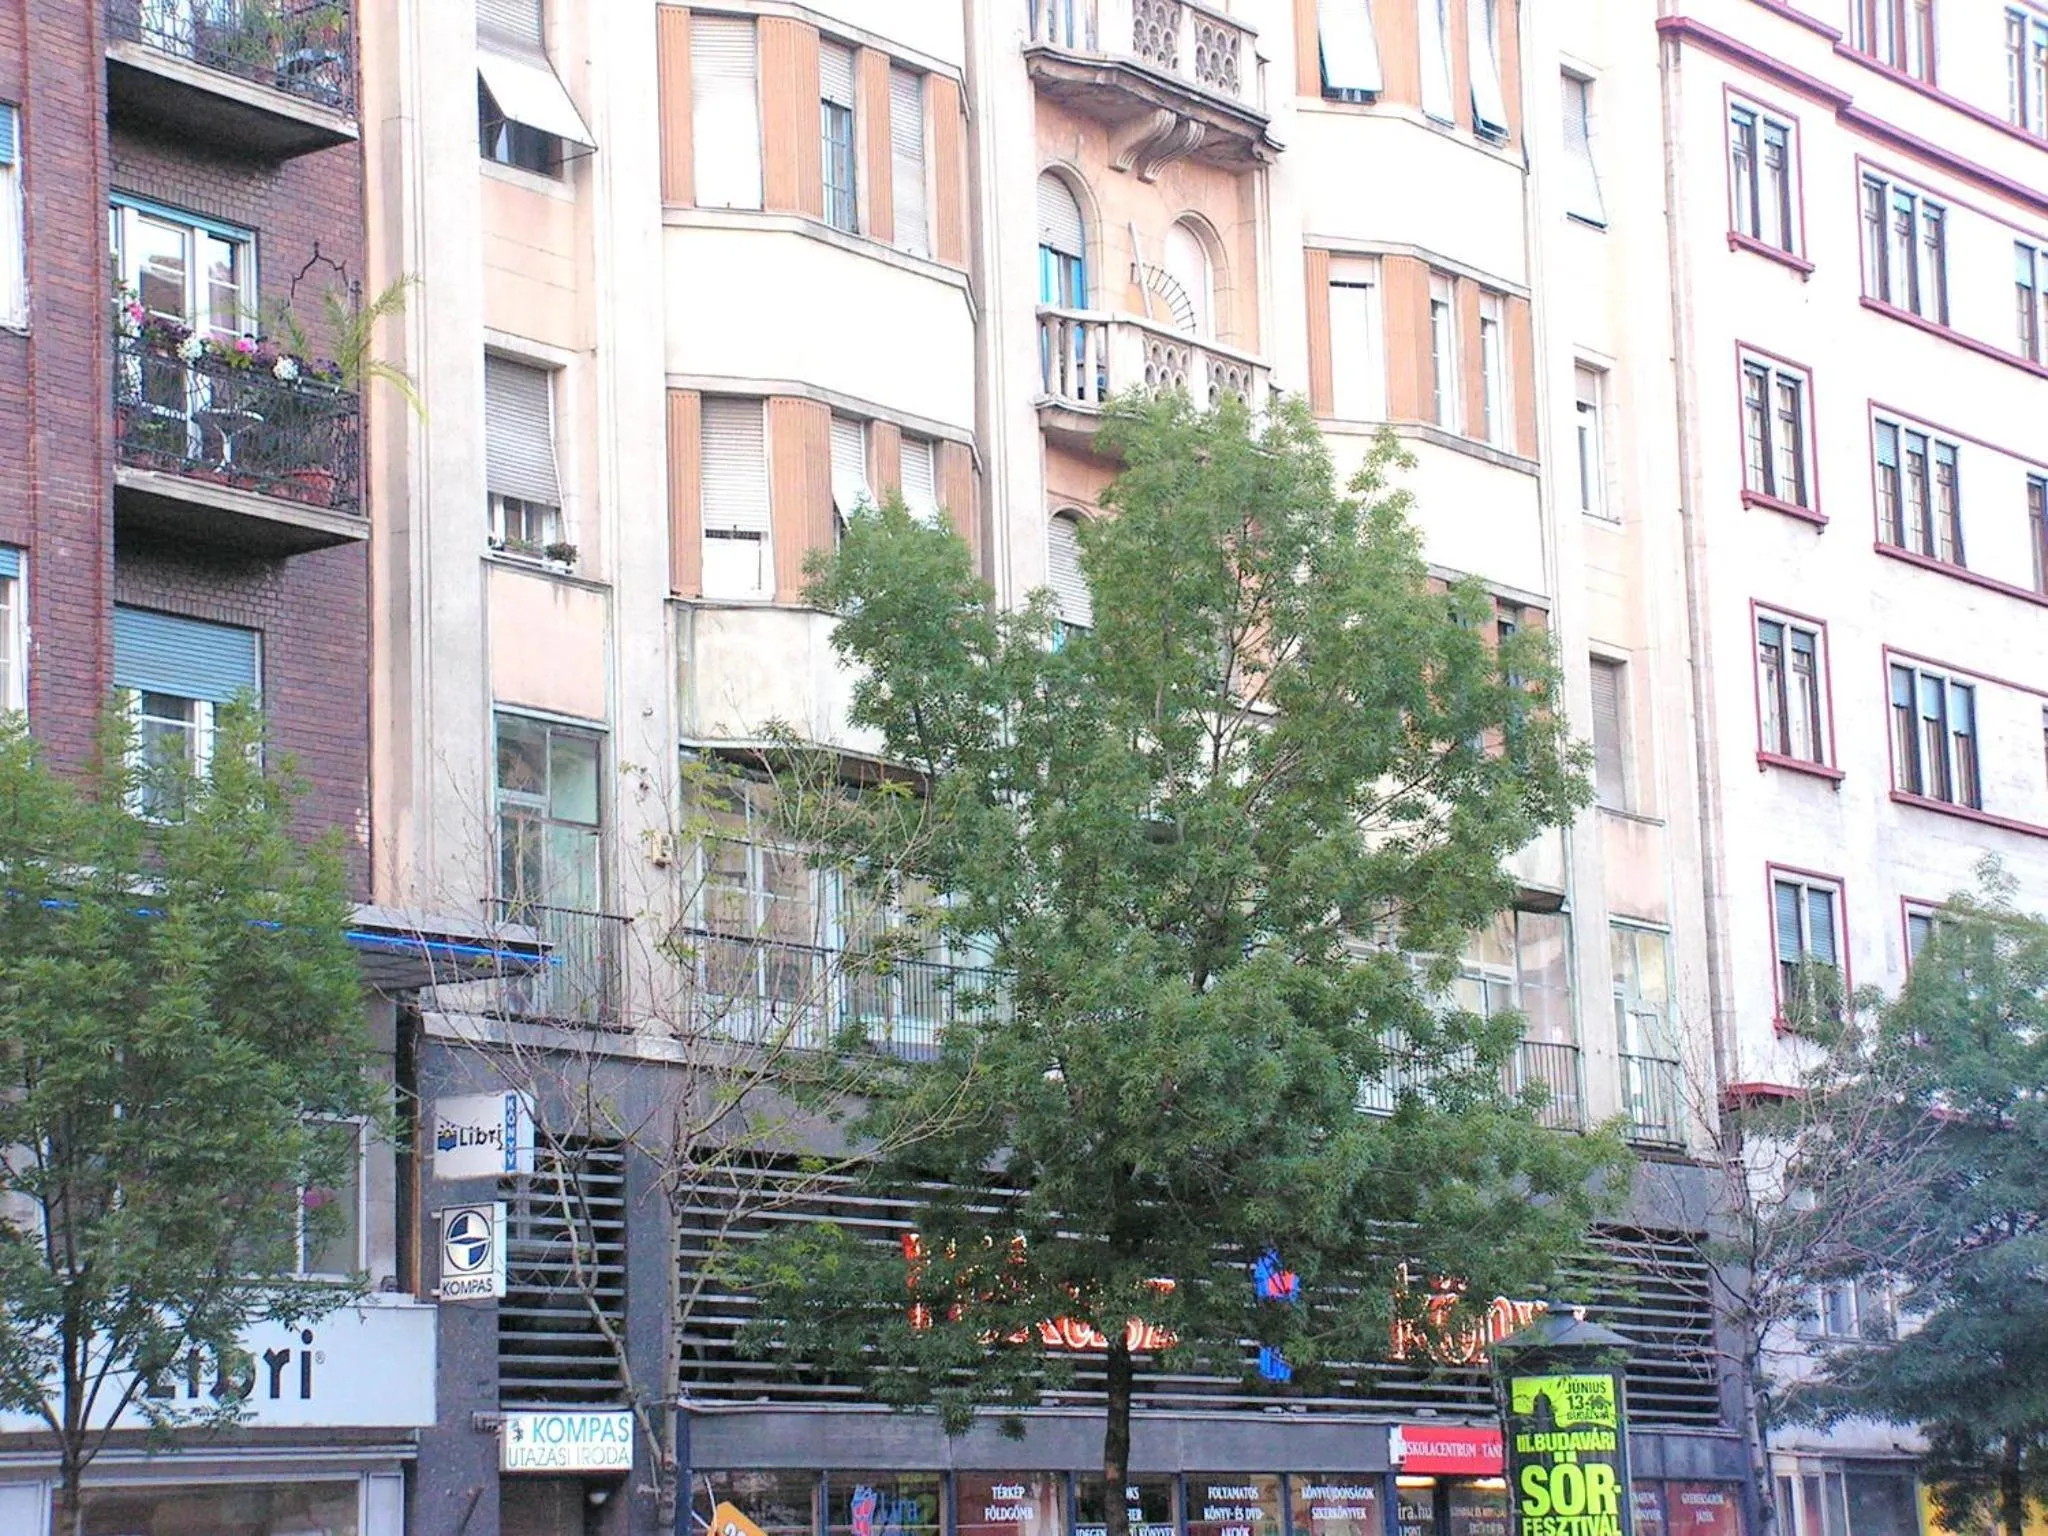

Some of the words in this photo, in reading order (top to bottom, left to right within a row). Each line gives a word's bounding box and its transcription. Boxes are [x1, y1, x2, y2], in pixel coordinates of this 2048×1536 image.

[460, 1124, 503, 1150] Libri
[442, 1278, 493, 1297] KOMPAS
[1565, 1380, 1607, 1395] JÚNIUS
[532, 1416, 630, 1443] KOMPAS
[576, 1446, 630, 1466] IRODA
[991, 1483, 1025, 1500] TÉRKÉP
[1521, 1450, 1622, 1516] SÖR-
[1207, 1486, 1259, 1500] FOLYAMATOS
[984, 1504, 1034, 1520] FÖLDGÖMB
[1203, 1505, 1234, 1521] KÖNYV-
[1235, 1505, 1244, 1521] ÉS
[1522, 1511, 1622, 1536] FESZTIVÁL
